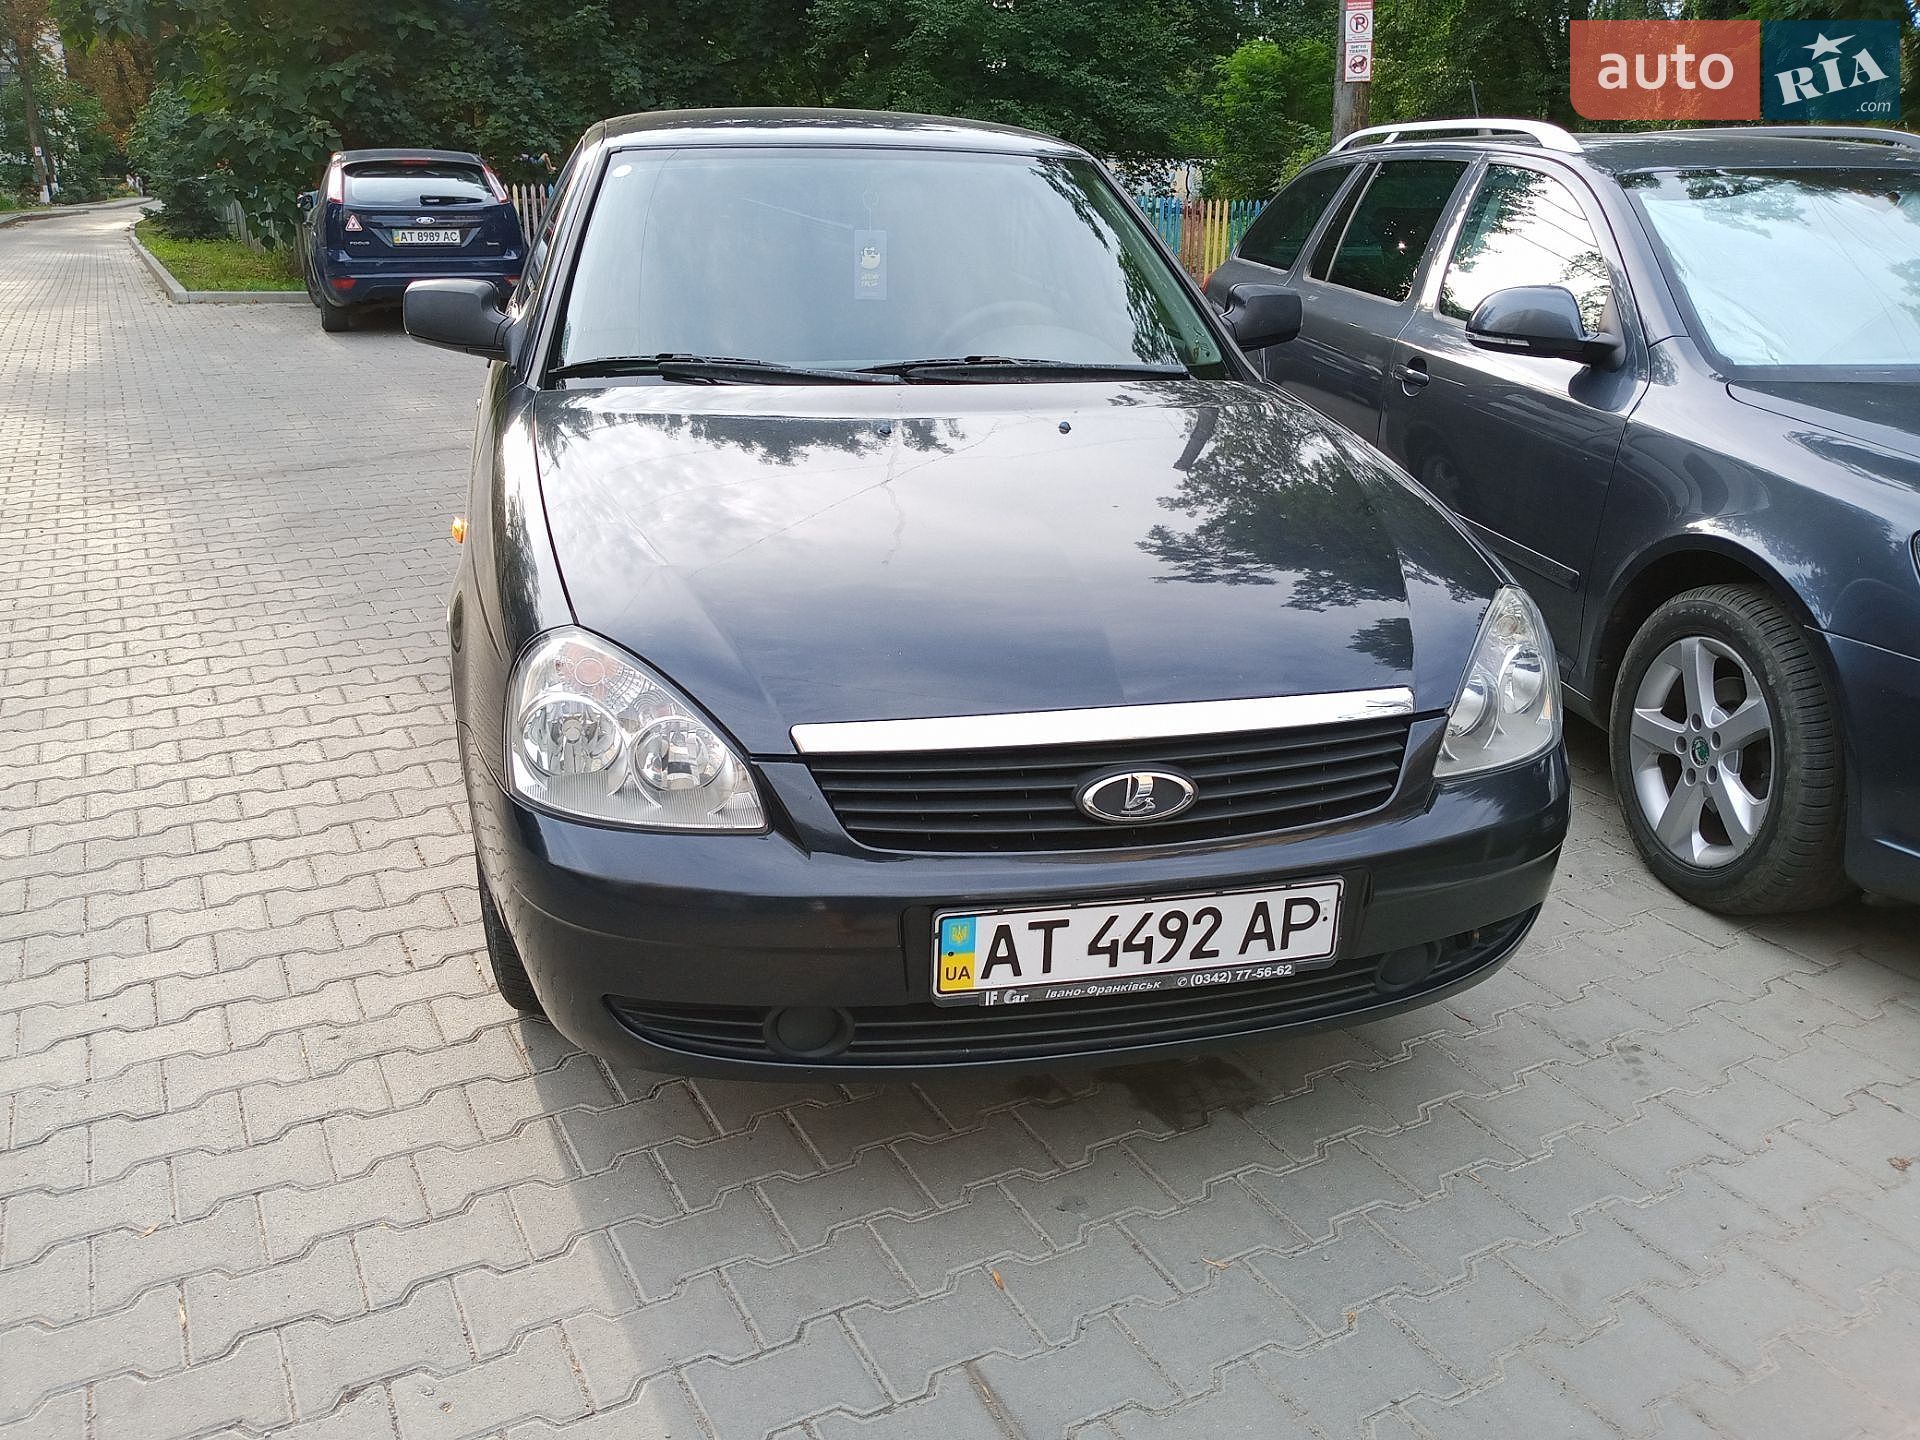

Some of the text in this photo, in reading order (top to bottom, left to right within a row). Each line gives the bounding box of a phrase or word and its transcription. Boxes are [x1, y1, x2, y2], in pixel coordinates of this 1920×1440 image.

[400, 231, 458, 242] AT 8989 AC
[980, 896, 1321, 980] AT 4492 AP
[945, 966, 971, 981] UA
[984, 964, 1293, 1006] IF Car Івано-Франківськ (0342) 77-56-62
